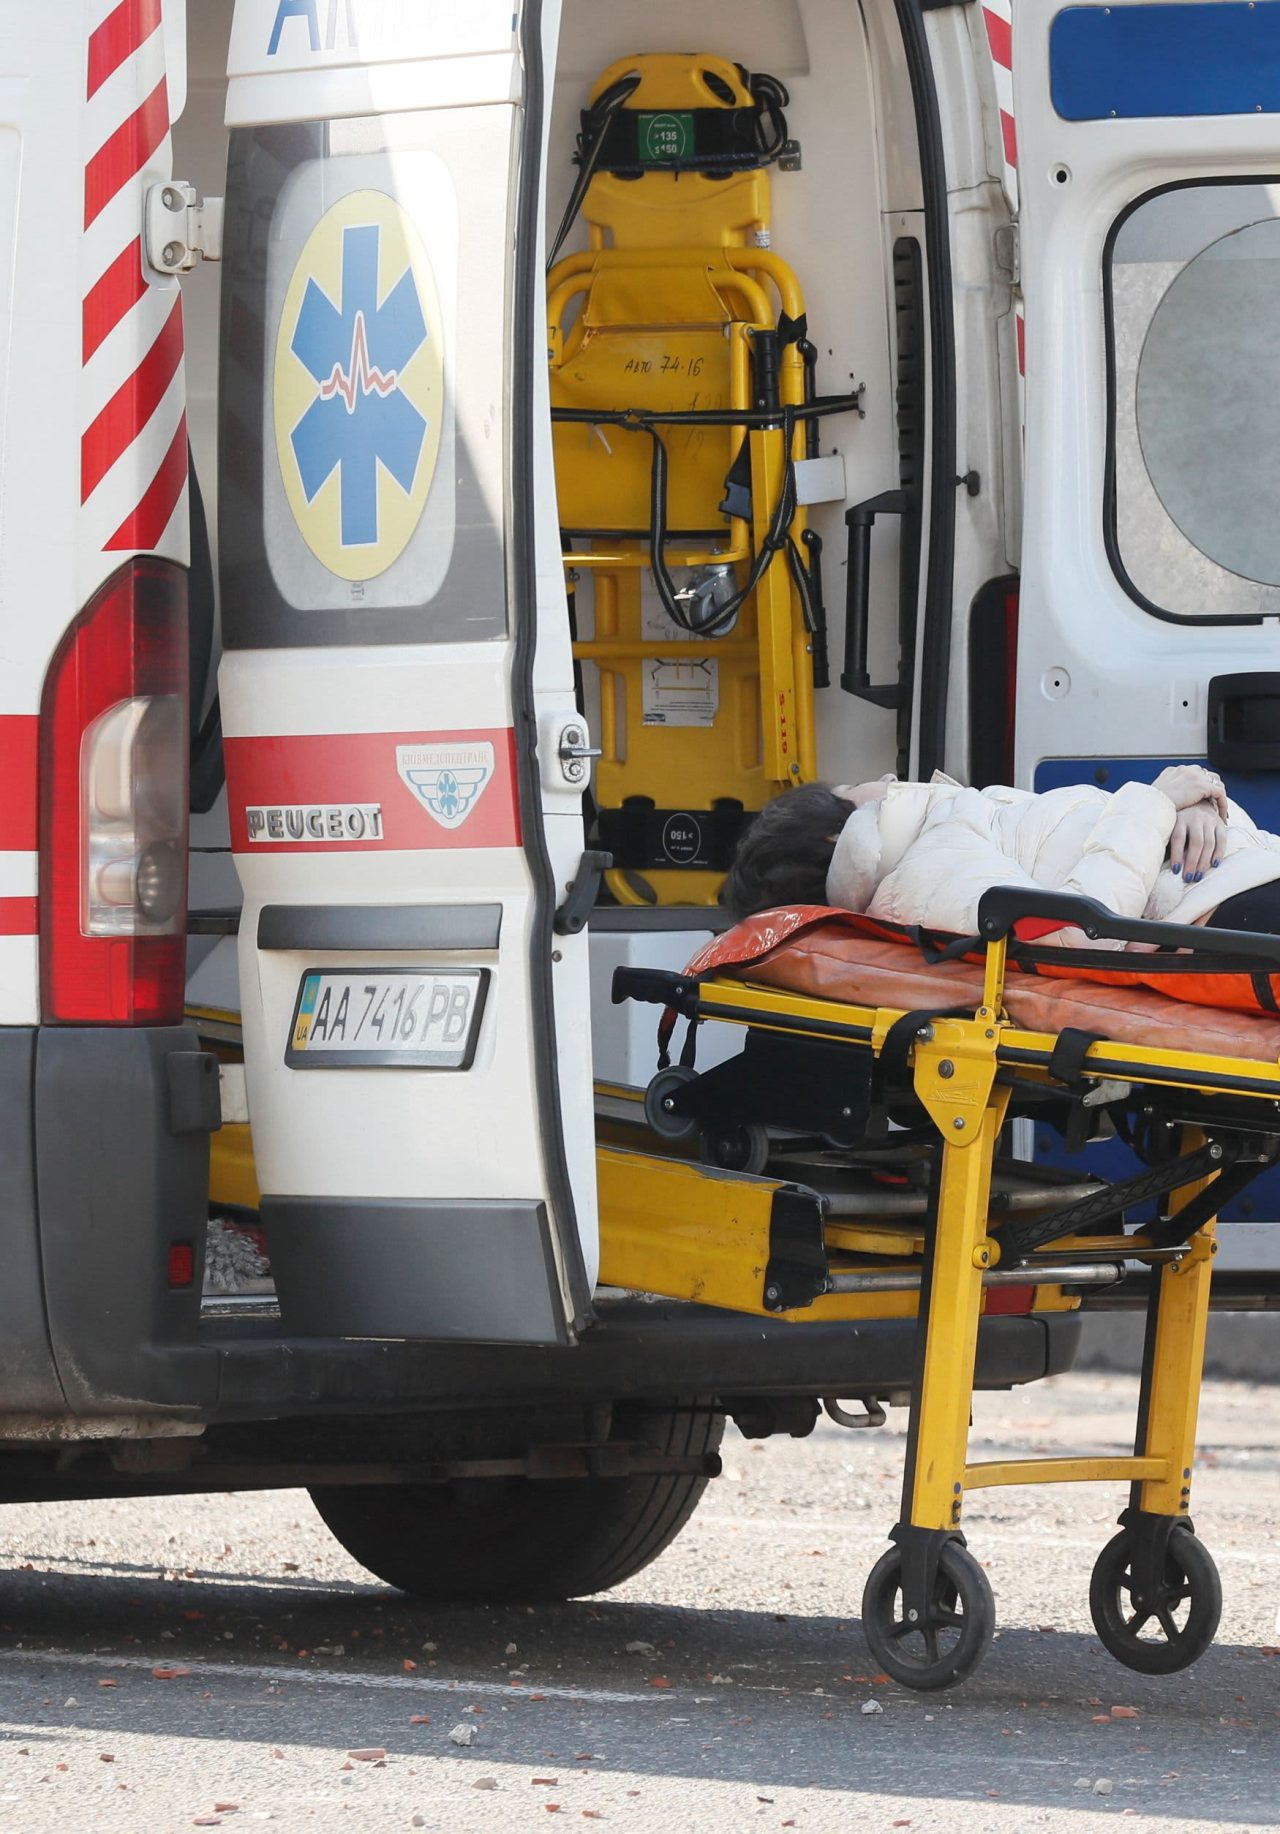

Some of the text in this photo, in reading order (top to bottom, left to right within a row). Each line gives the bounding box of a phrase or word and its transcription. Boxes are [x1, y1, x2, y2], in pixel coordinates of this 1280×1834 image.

[661, 132, 677, 141] 135
[246, 807, 381, 839] PEUGEOT
[670, 830, 687, 840] 150
[296, 1026, 308, 1041] UA
